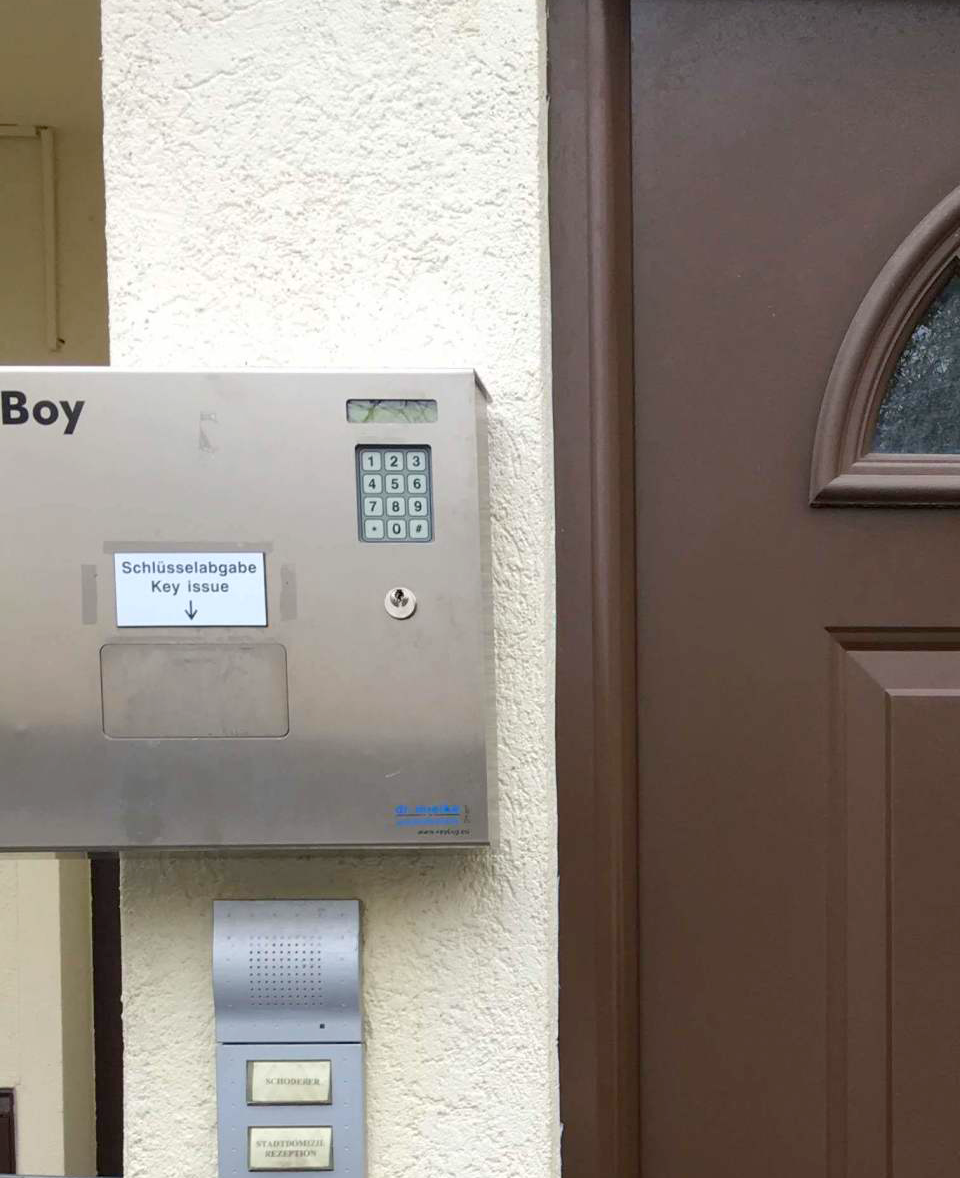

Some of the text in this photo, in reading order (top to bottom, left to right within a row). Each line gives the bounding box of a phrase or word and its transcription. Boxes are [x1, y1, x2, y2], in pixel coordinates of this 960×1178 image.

[1, 391, 86, 435] Boy
[368, 456, 420, 467] 1 2 3
[369, 478, 421, 489] 4 5 6
[369, 501, 422, 512] 7 8 9
[392, 524, 401, 534] 0
[121, 560, 257, 576] Schlüsselabgabe
[151, 580, 230, 596] Key issue
[264, 1149, 317, 1158] REZEPTION
